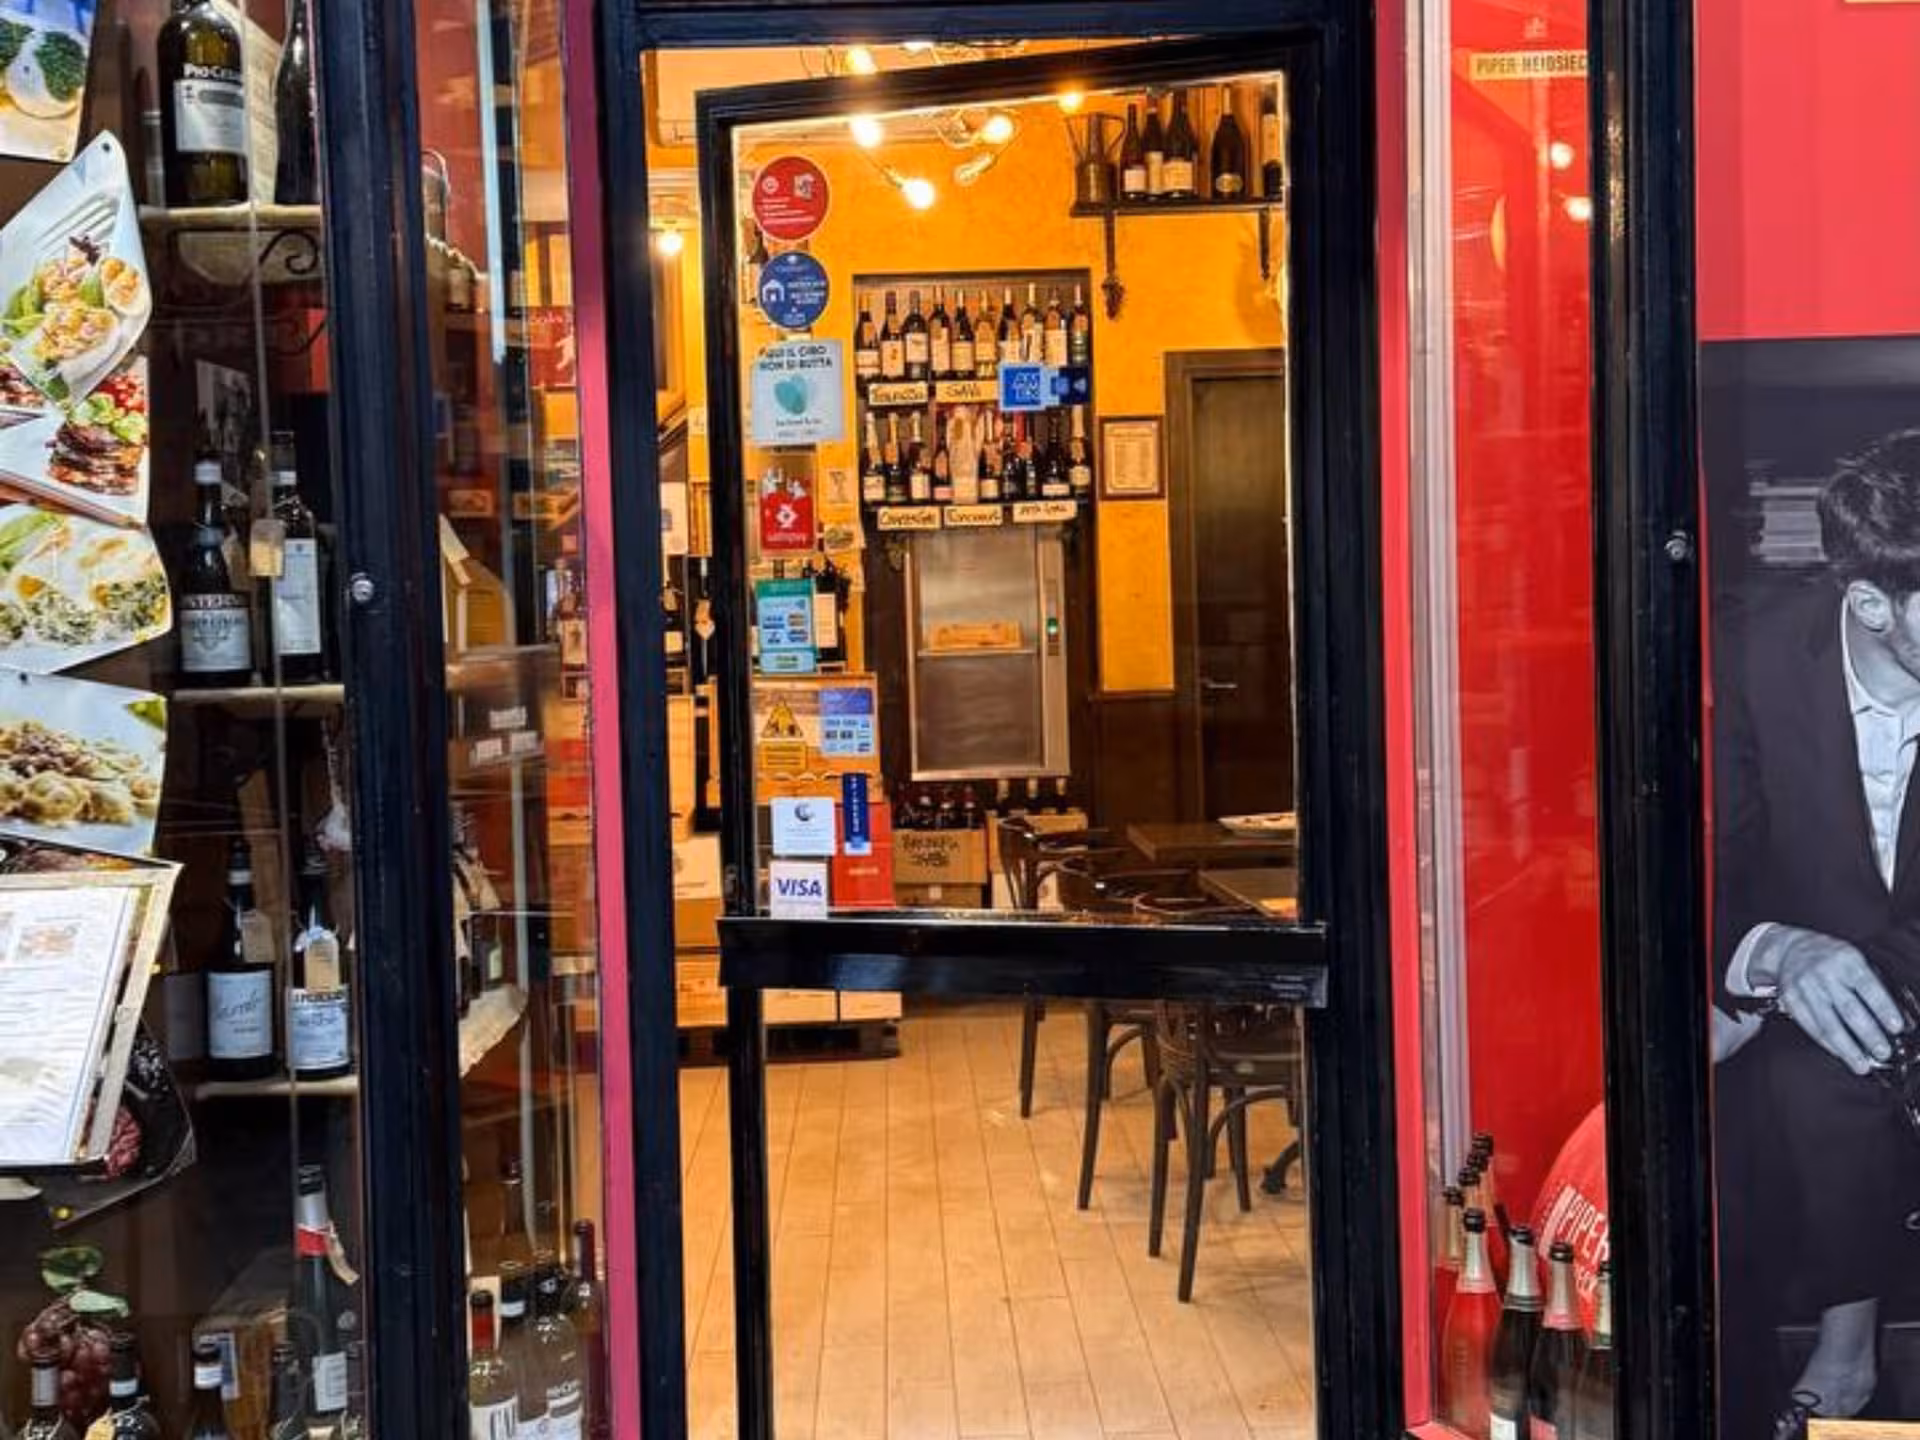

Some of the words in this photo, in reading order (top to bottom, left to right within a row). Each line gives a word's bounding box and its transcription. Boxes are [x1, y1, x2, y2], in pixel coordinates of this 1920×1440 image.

[799, 345, 827, 357] CIBO
[759, 361, 784, 371] NON
[799, 357, 833, 369] BUTTA
[1012, 371, 1041, 387] AM
[777, 878, 823, 897] VISA
